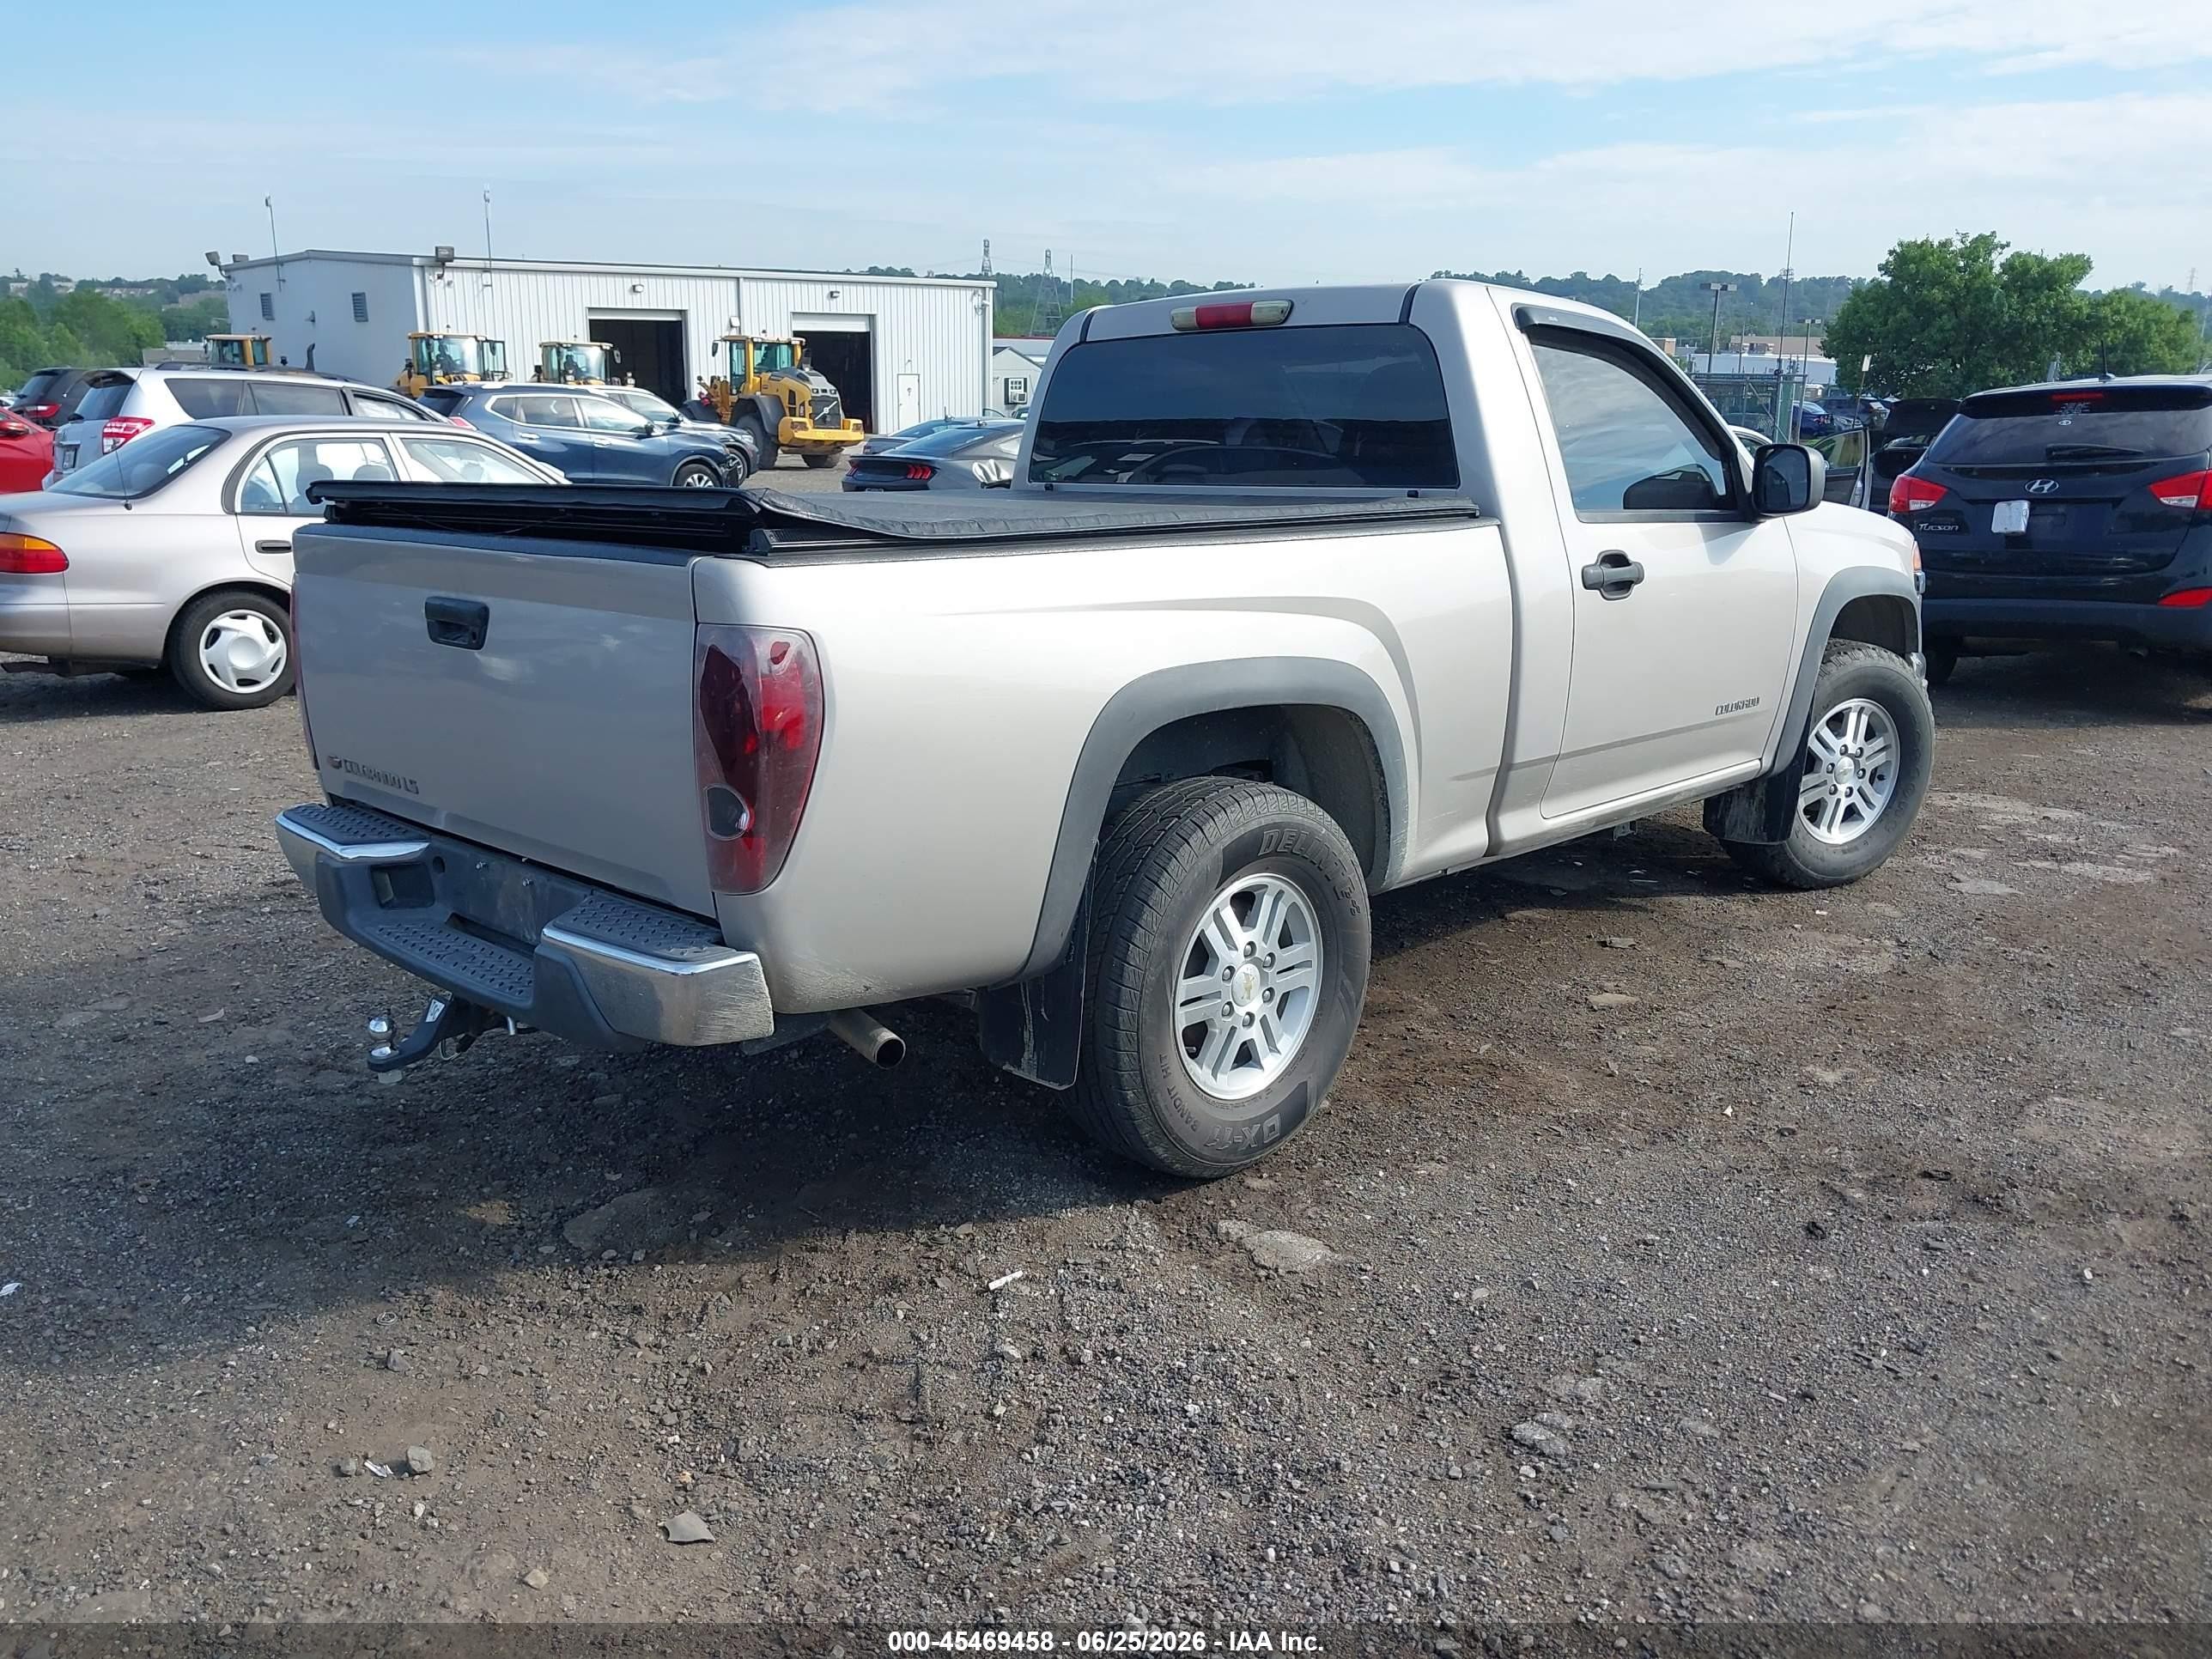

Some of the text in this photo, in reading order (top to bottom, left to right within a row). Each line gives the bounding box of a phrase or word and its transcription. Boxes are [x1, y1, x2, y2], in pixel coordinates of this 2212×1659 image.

[1918, 523, 1959, 532] Tucson
[1257, 828, 1356, 901] DELINTE
[1167, 1085, 1200, 1133] BANDIT
[1203, 1113, 1282, 1152] DX-11
